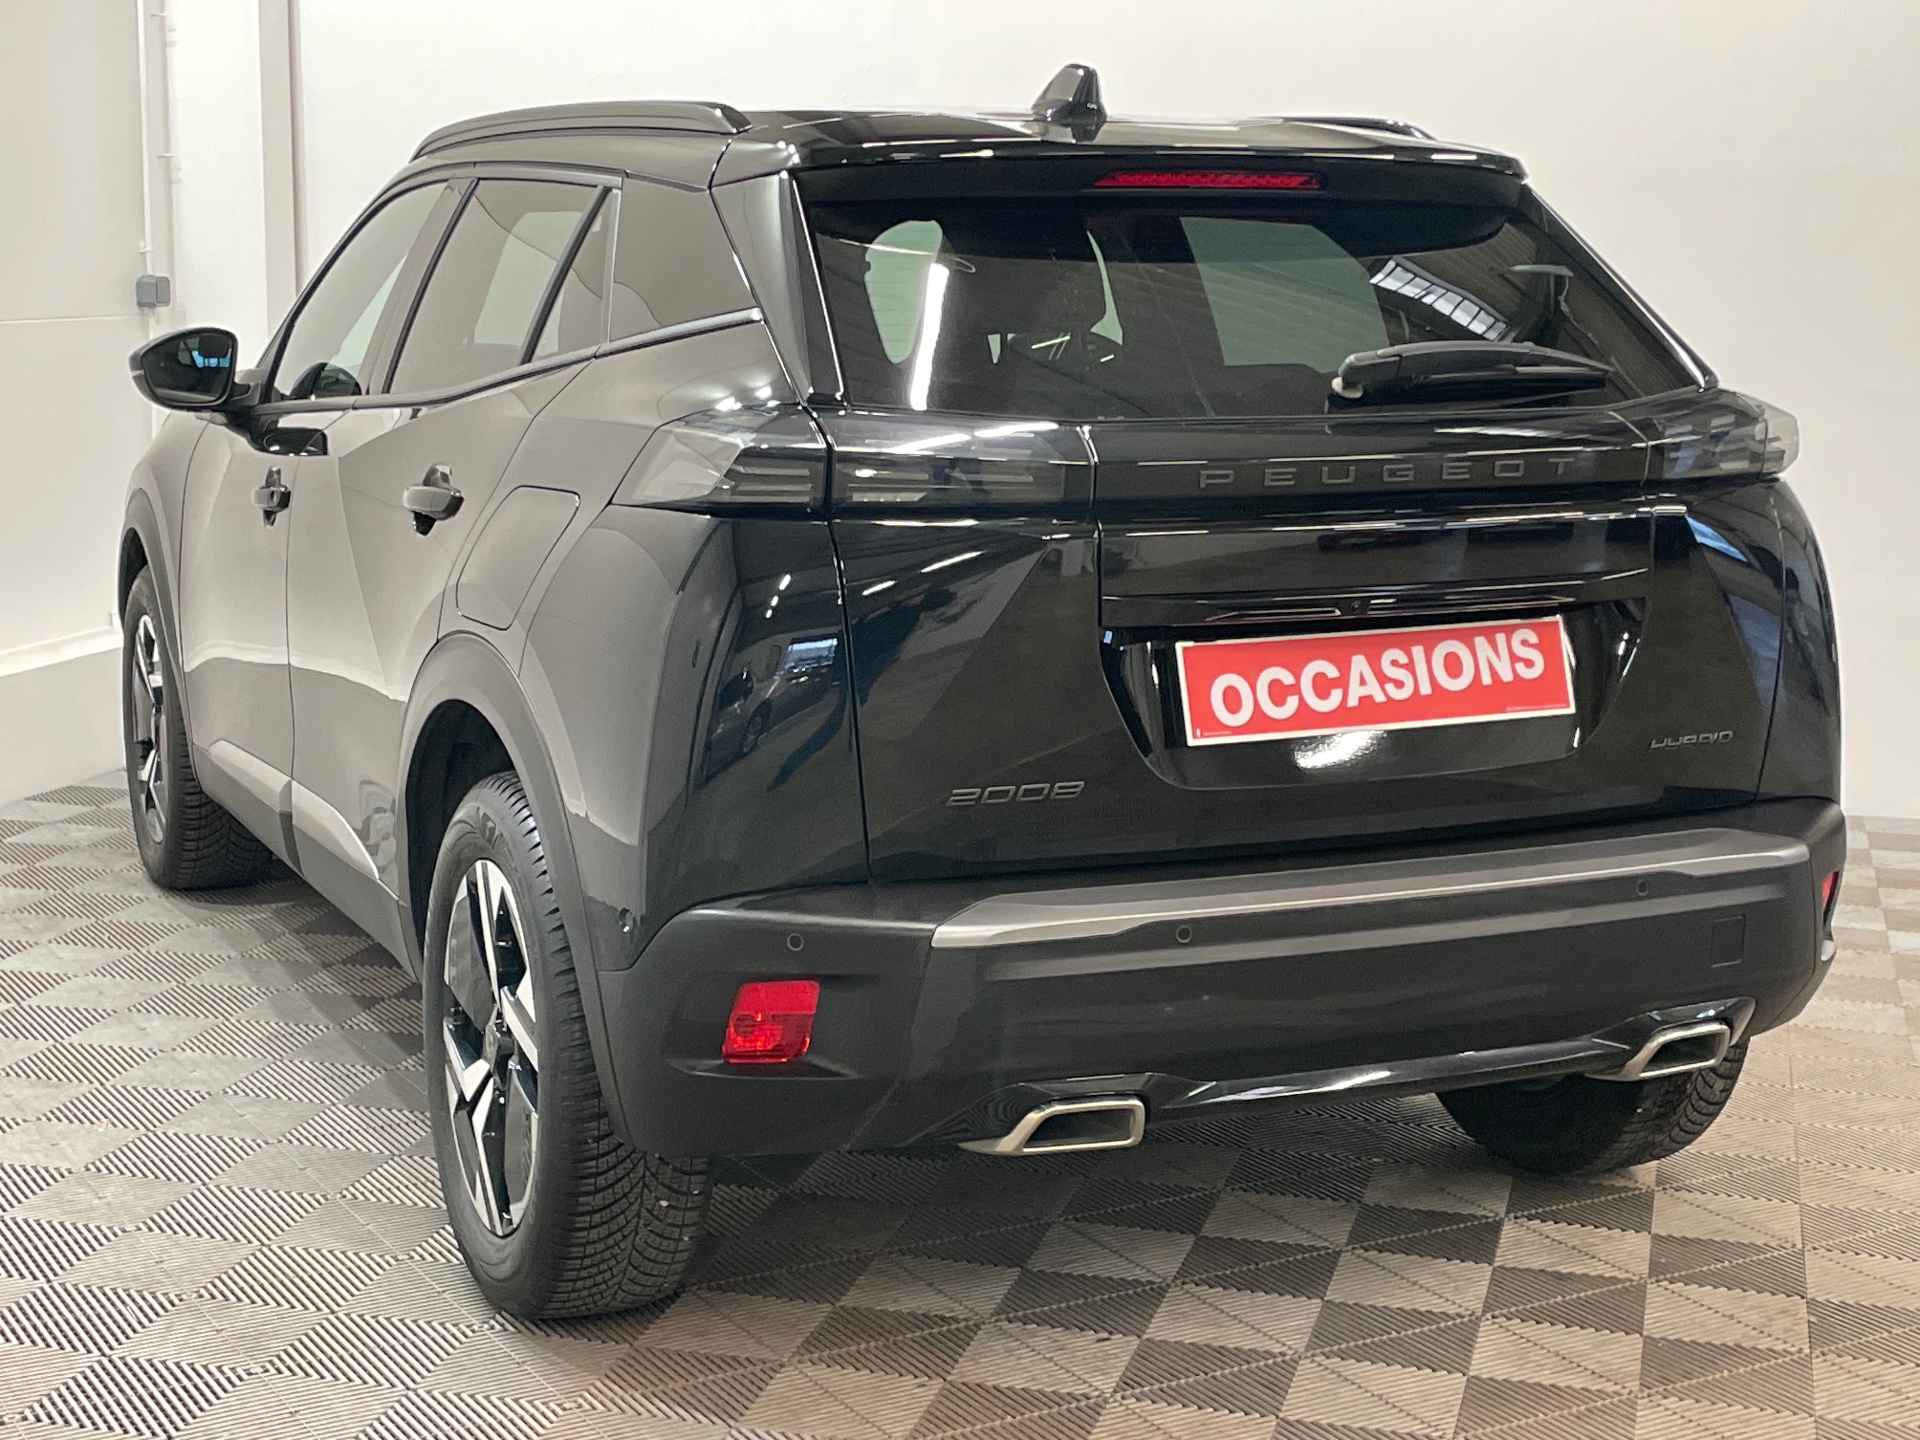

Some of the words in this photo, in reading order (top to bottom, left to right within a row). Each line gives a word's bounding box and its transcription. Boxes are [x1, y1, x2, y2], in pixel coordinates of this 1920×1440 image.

[1200, 457, 1575, 489] PEUGEOT
[1210, 628, 1545, 728] OCCASIONS
[946, 780, 1085, 807] 2008
